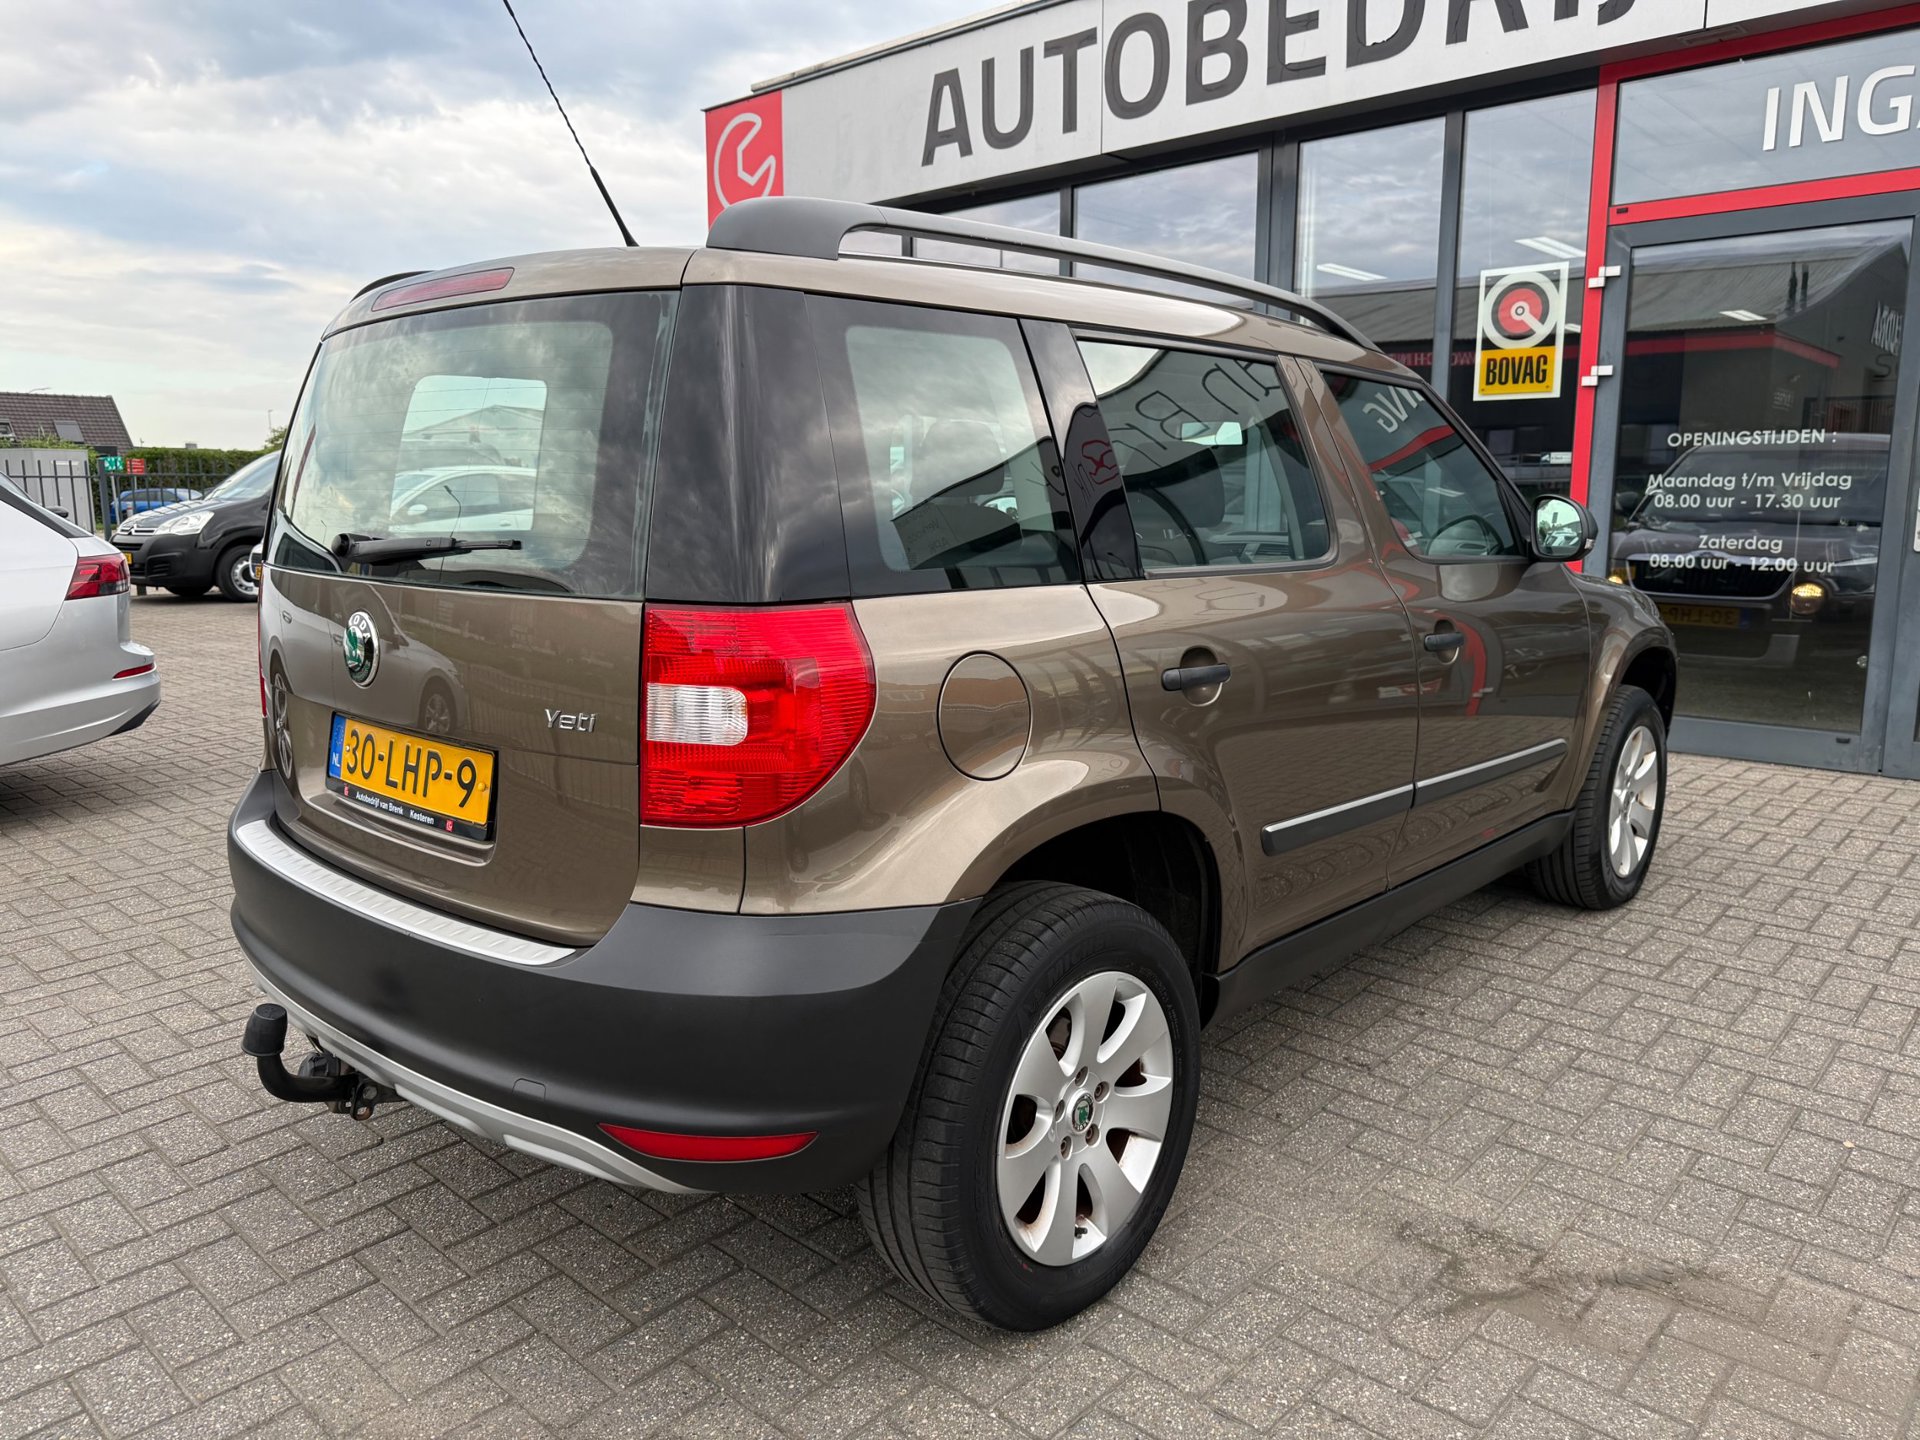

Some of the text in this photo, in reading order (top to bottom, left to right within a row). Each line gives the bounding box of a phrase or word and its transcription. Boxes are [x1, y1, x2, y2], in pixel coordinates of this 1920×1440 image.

[921, 0, 1636, 166] AUTOBED
[1762, 65, 1920, 151] ING
[1485, 354, 1548, 386] BOVAG
[1667, 429, 1825, 447] OPENINGSTIJDEN
[1648, 472, 1852, 490] Maandag t/m Vrijdag
[1654, 494, 1700, 508] 08.00
[1706, 496, 1735, 508] uur
[1755, 494, 1803, 508] 17.30
[1809, 496, 1841, 508] uur
[1699, 535, 1783, 553] Zaterdag
[1649, 554, 1696, 569] 08.00
[1701, 556, 1730, 570] uur
[1749, 557, 1797, 572] 12.00
[1803, 560, 1836, 573] uur
[545, 708, 597, 733] Yeti
[332, 752, 340, 767] NL
[347, 728, 477, 808] 30-LHP-9
[355, 791, 435, 825] Autobedrijf van Brenk Kesteren
